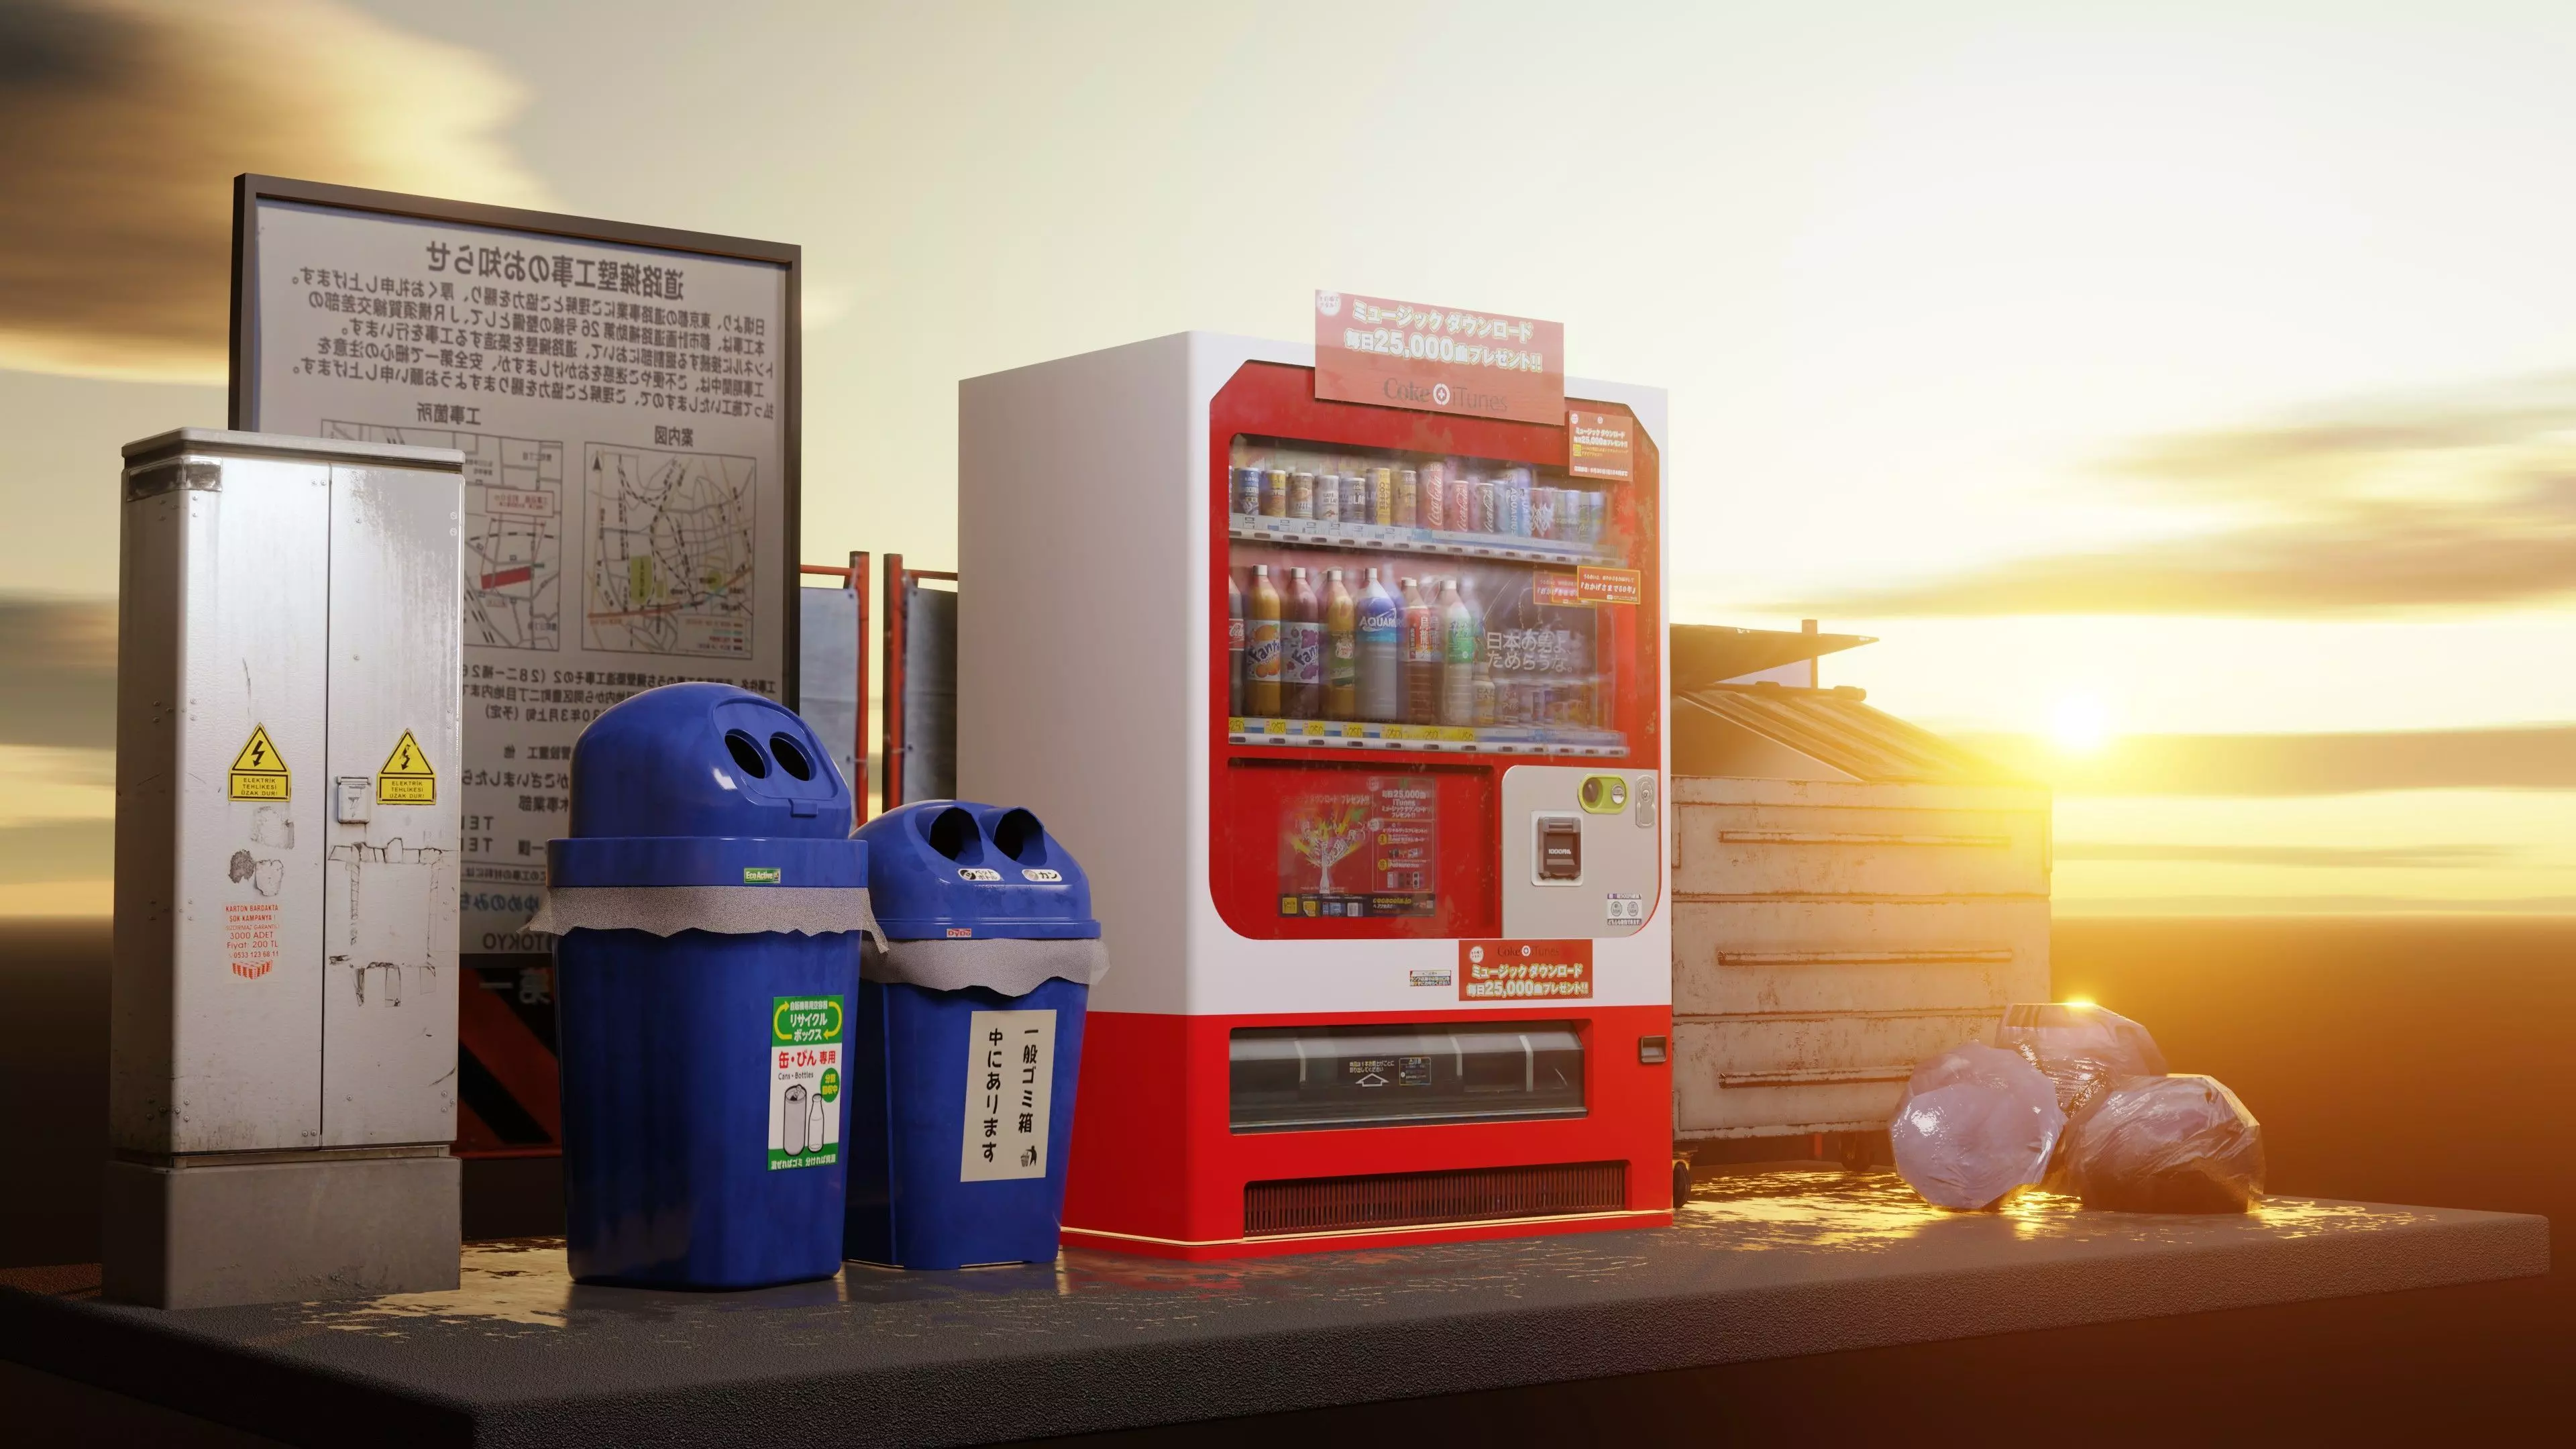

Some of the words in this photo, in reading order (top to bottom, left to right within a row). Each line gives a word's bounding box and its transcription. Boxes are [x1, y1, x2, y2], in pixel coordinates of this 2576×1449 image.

[1352, 299, 1444, 332] ミュージック
[1446, 312, 1534, 344] ダウンロード
[1383, 377, 1430, 402] Coke
[1451, 385, 1509, 413] iTunes
[1040, 870, 1058, 880] カン
[230, 932, 251, 940] 3000
[1471, 963, 1527, 979] ミュージック
[1529, 963, 1583, 979] ダウンロード
[790, 1013, 828, 1028] リサイクル
[794, 1028, 822, 1042] ボックス
[819, 1051, 836, 1065] 専用
[1018, 1028, 1039, 1134] 一般ゴミ箱
[981, 1027, 1004, 1163] 中にあります
